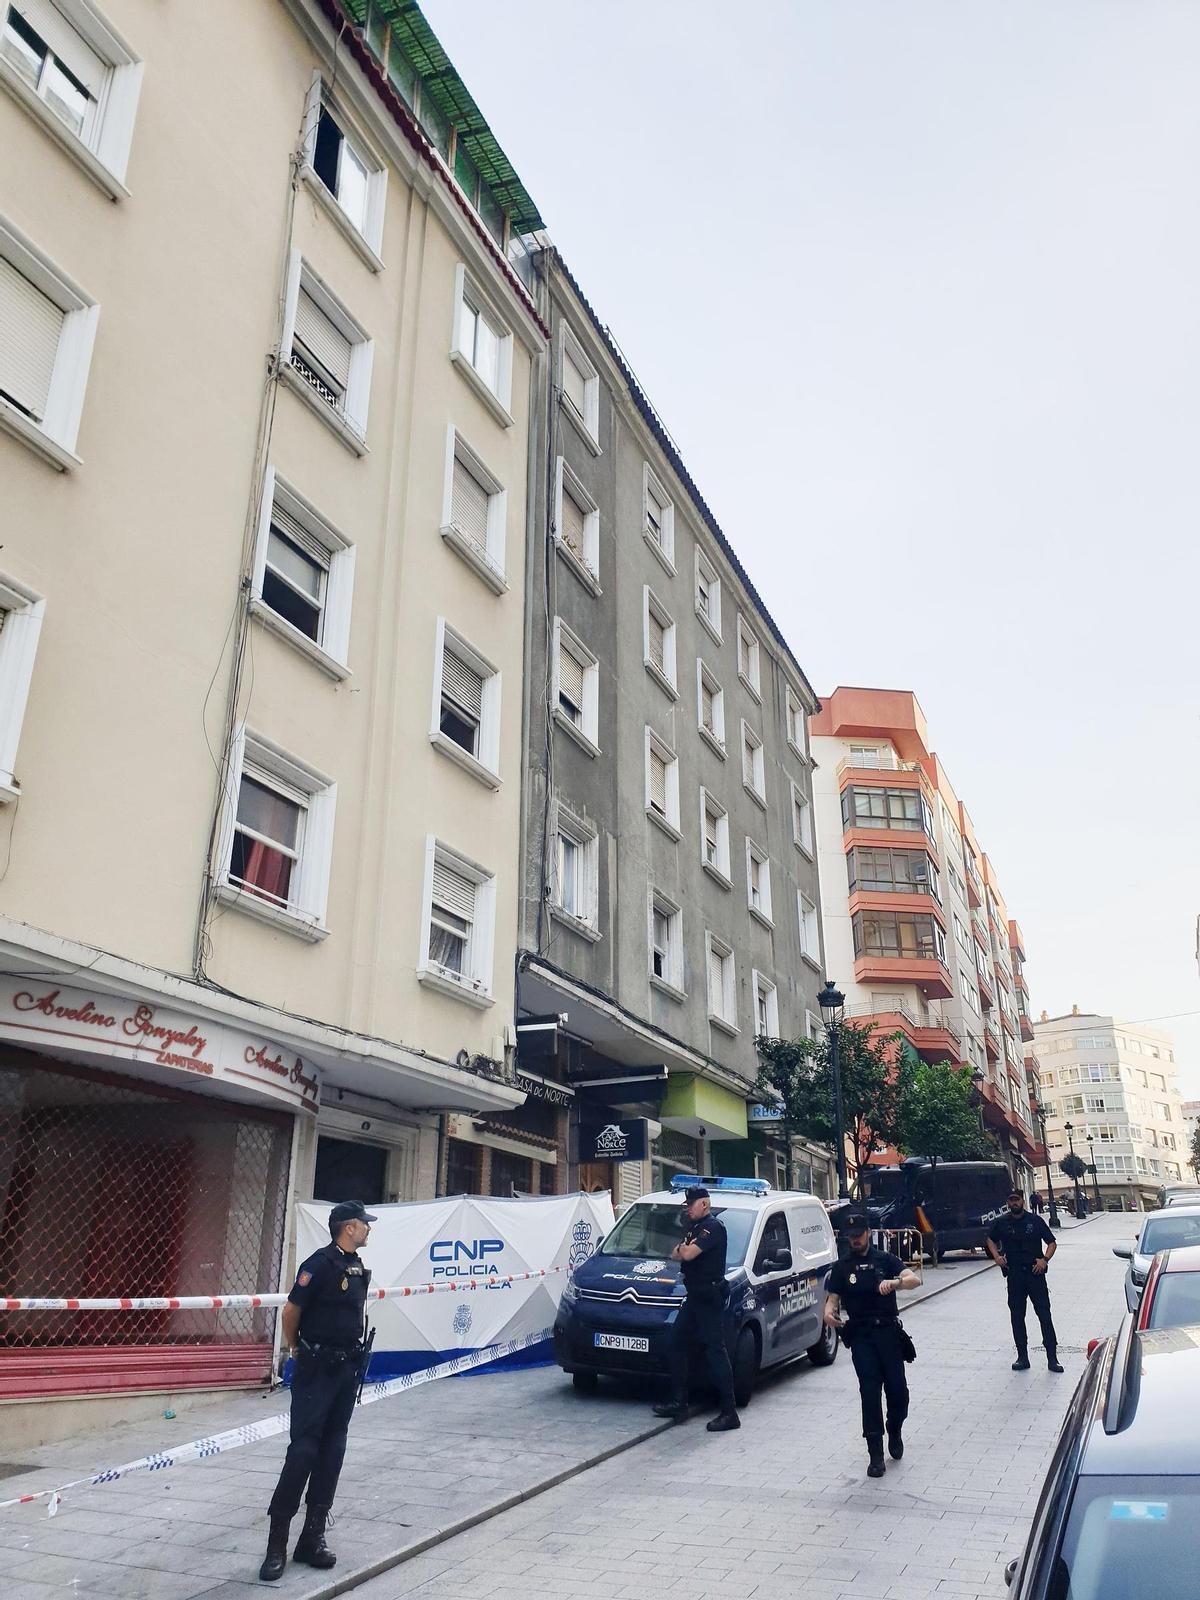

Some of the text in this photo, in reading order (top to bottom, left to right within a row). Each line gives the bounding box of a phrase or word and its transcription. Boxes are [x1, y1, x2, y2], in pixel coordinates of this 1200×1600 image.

[13, 991, 116, 1027] Avelino
[156, 1051, 214, 1075] ZAPATERIAS
[544, 1088, 569, 1106] NORTE
[981, 1201, 1011, 1225] POLICI
[429, 1239, 505, 1262] CNP
[433, 1264, 499, 1278] POLICIA
[602, 1273, 659, 1282] POLICIA
[779, 1278, 812, 1301] POLICIA
[780, 1292, 818, 1318] NACIONAL
[600, 1334, 648, 1351] CNP9112BB
